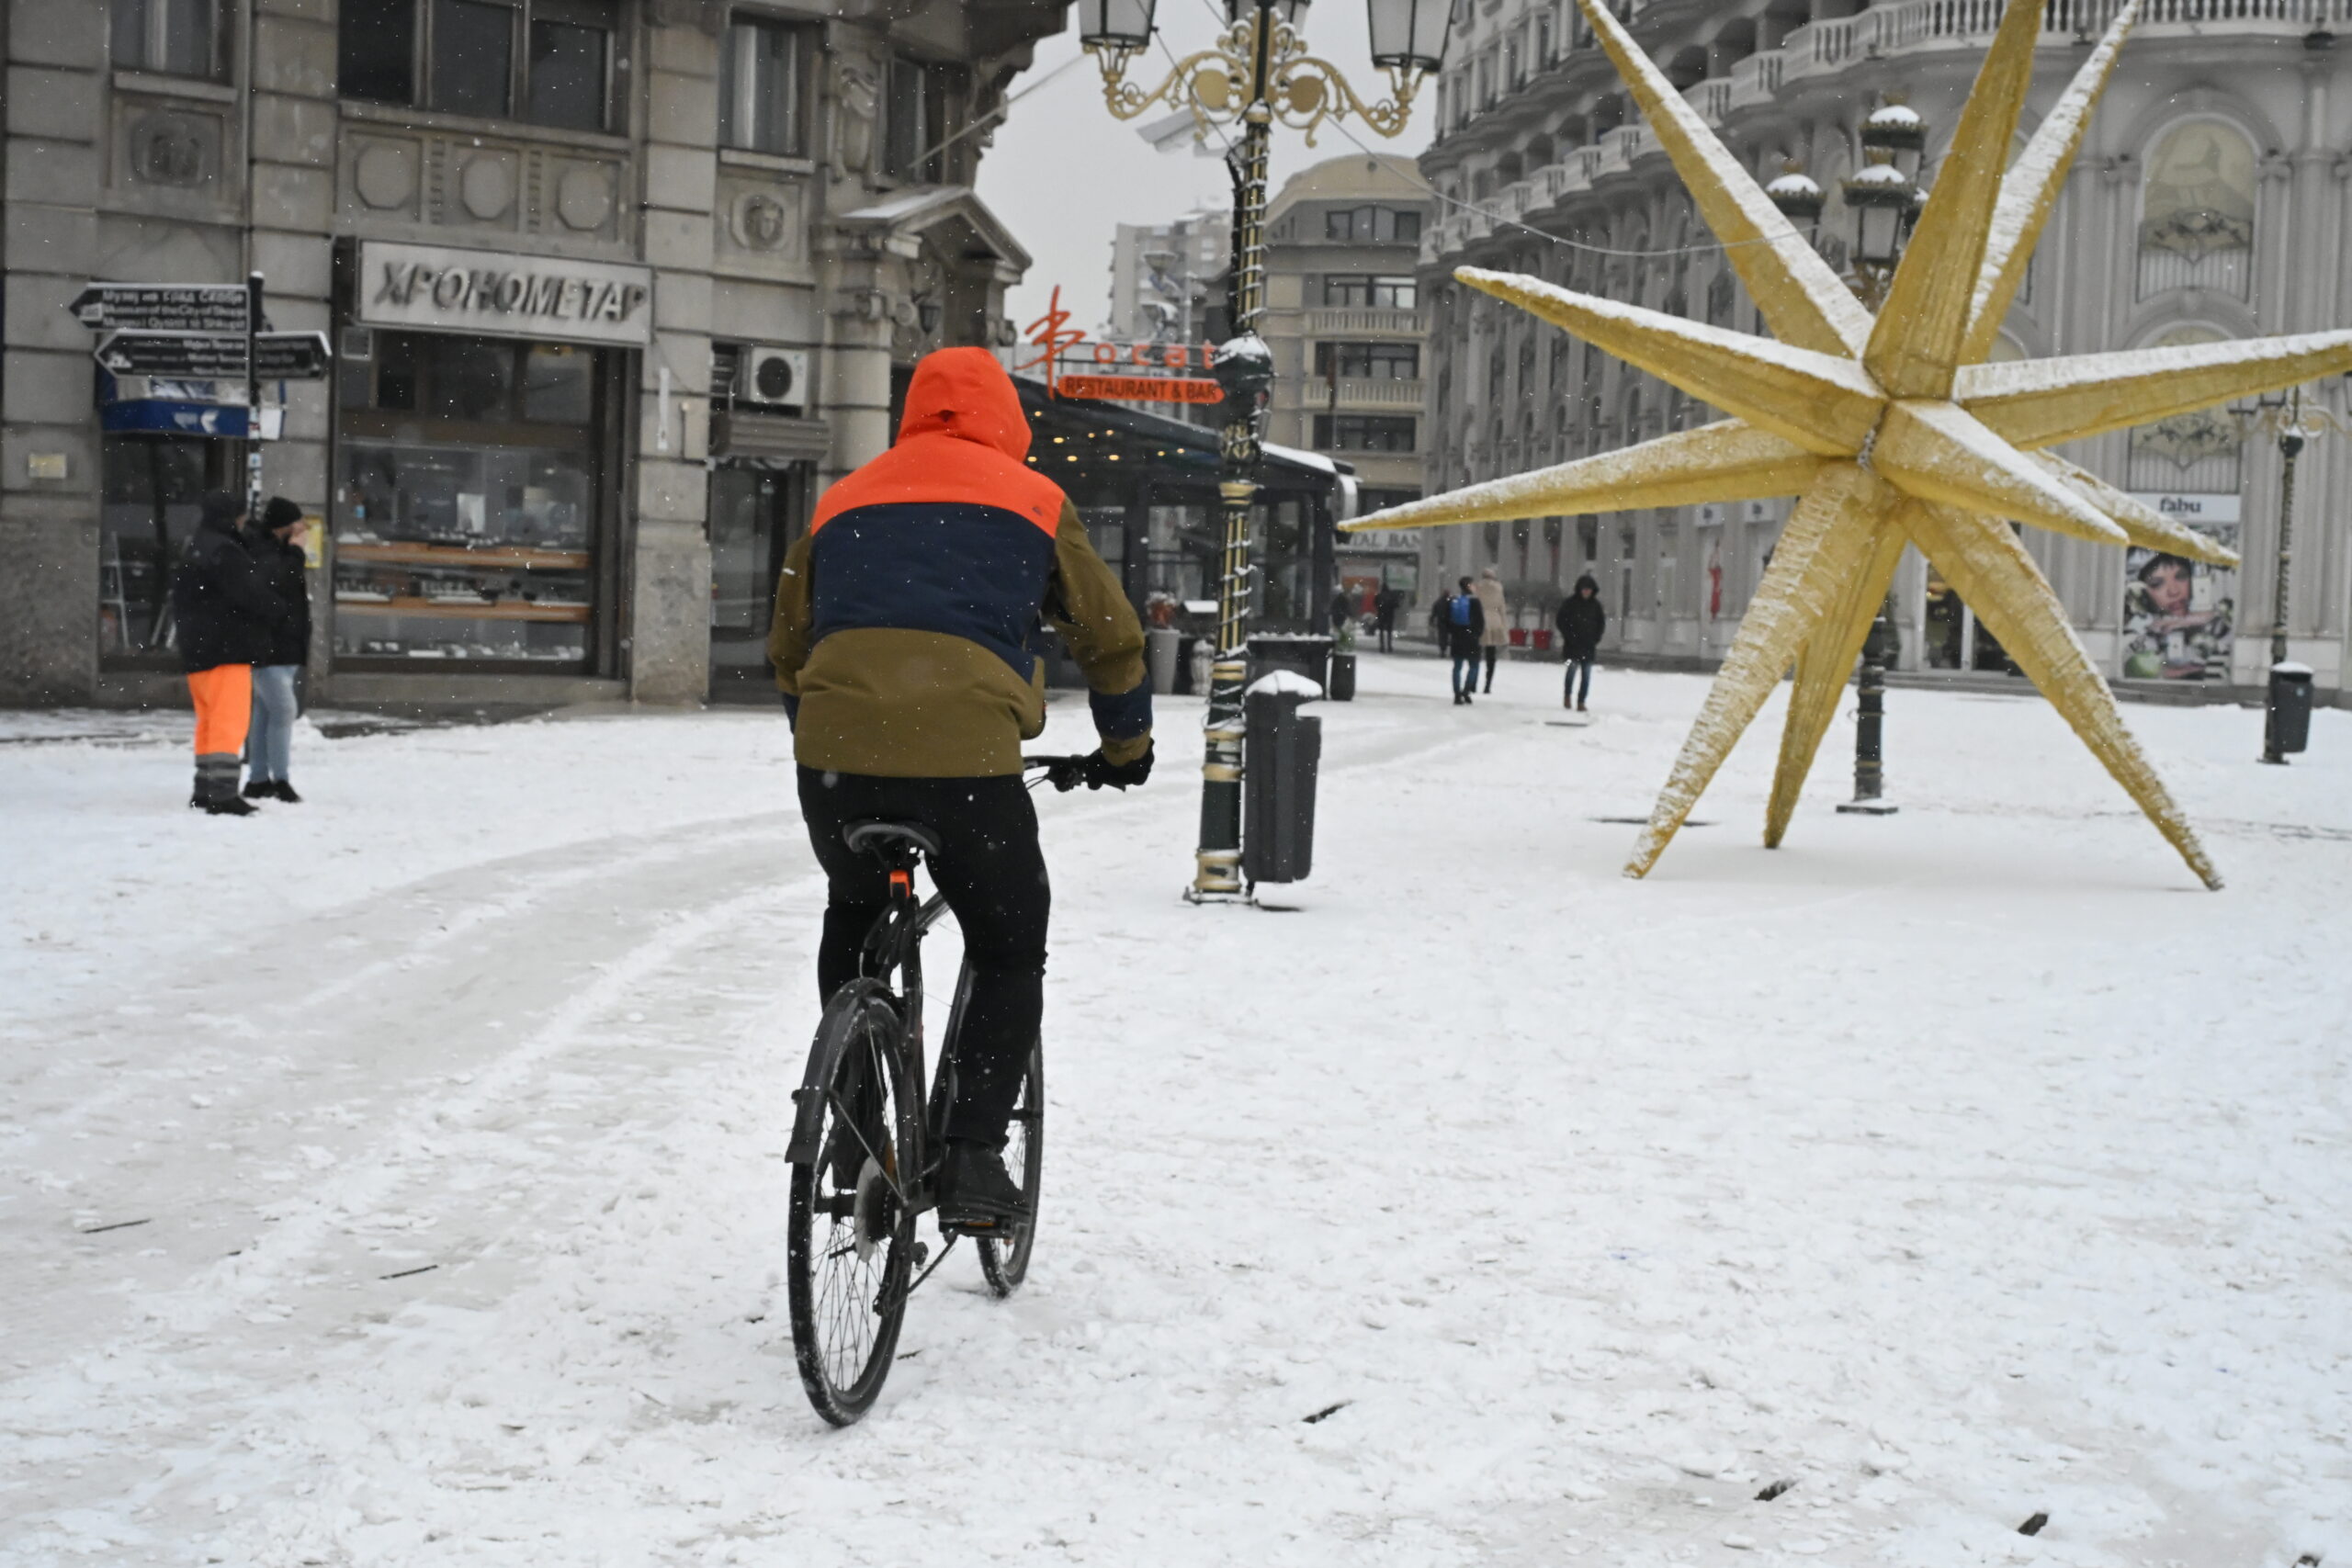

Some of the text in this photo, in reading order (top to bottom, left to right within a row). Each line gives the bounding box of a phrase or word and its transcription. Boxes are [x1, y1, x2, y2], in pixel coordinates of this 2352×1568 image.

[1064, 377, 1169, 400] RESTAURANT
[1185, 382, 1217, 402] BAR
[2160, 497, 2201, 513] fabu
